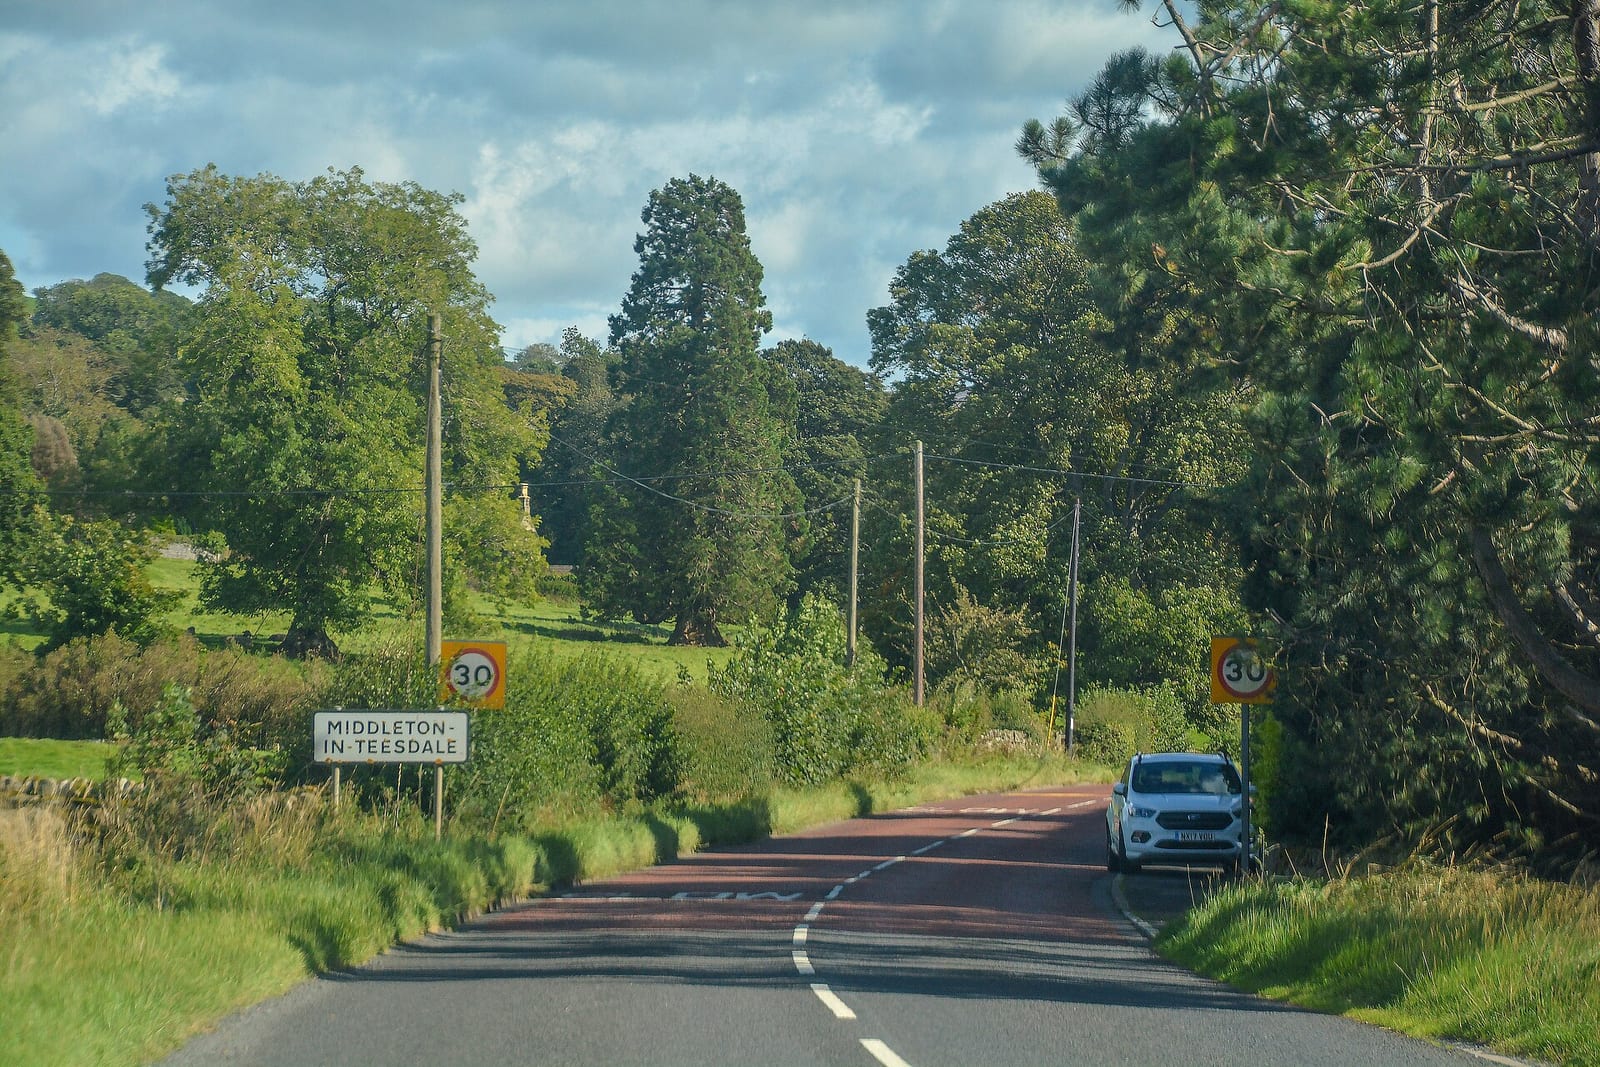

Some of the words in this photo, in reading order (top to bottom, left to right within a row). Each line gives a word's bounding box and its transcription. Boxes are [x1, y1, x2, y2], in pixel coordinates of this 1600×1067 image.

[455, 664, 491, 687] 30
[1225, 658, 1265, 681] 30
[327, 720, 454, 735] MIDDLETON-
[324, 739, 457, 754] IN-TEESDALE
